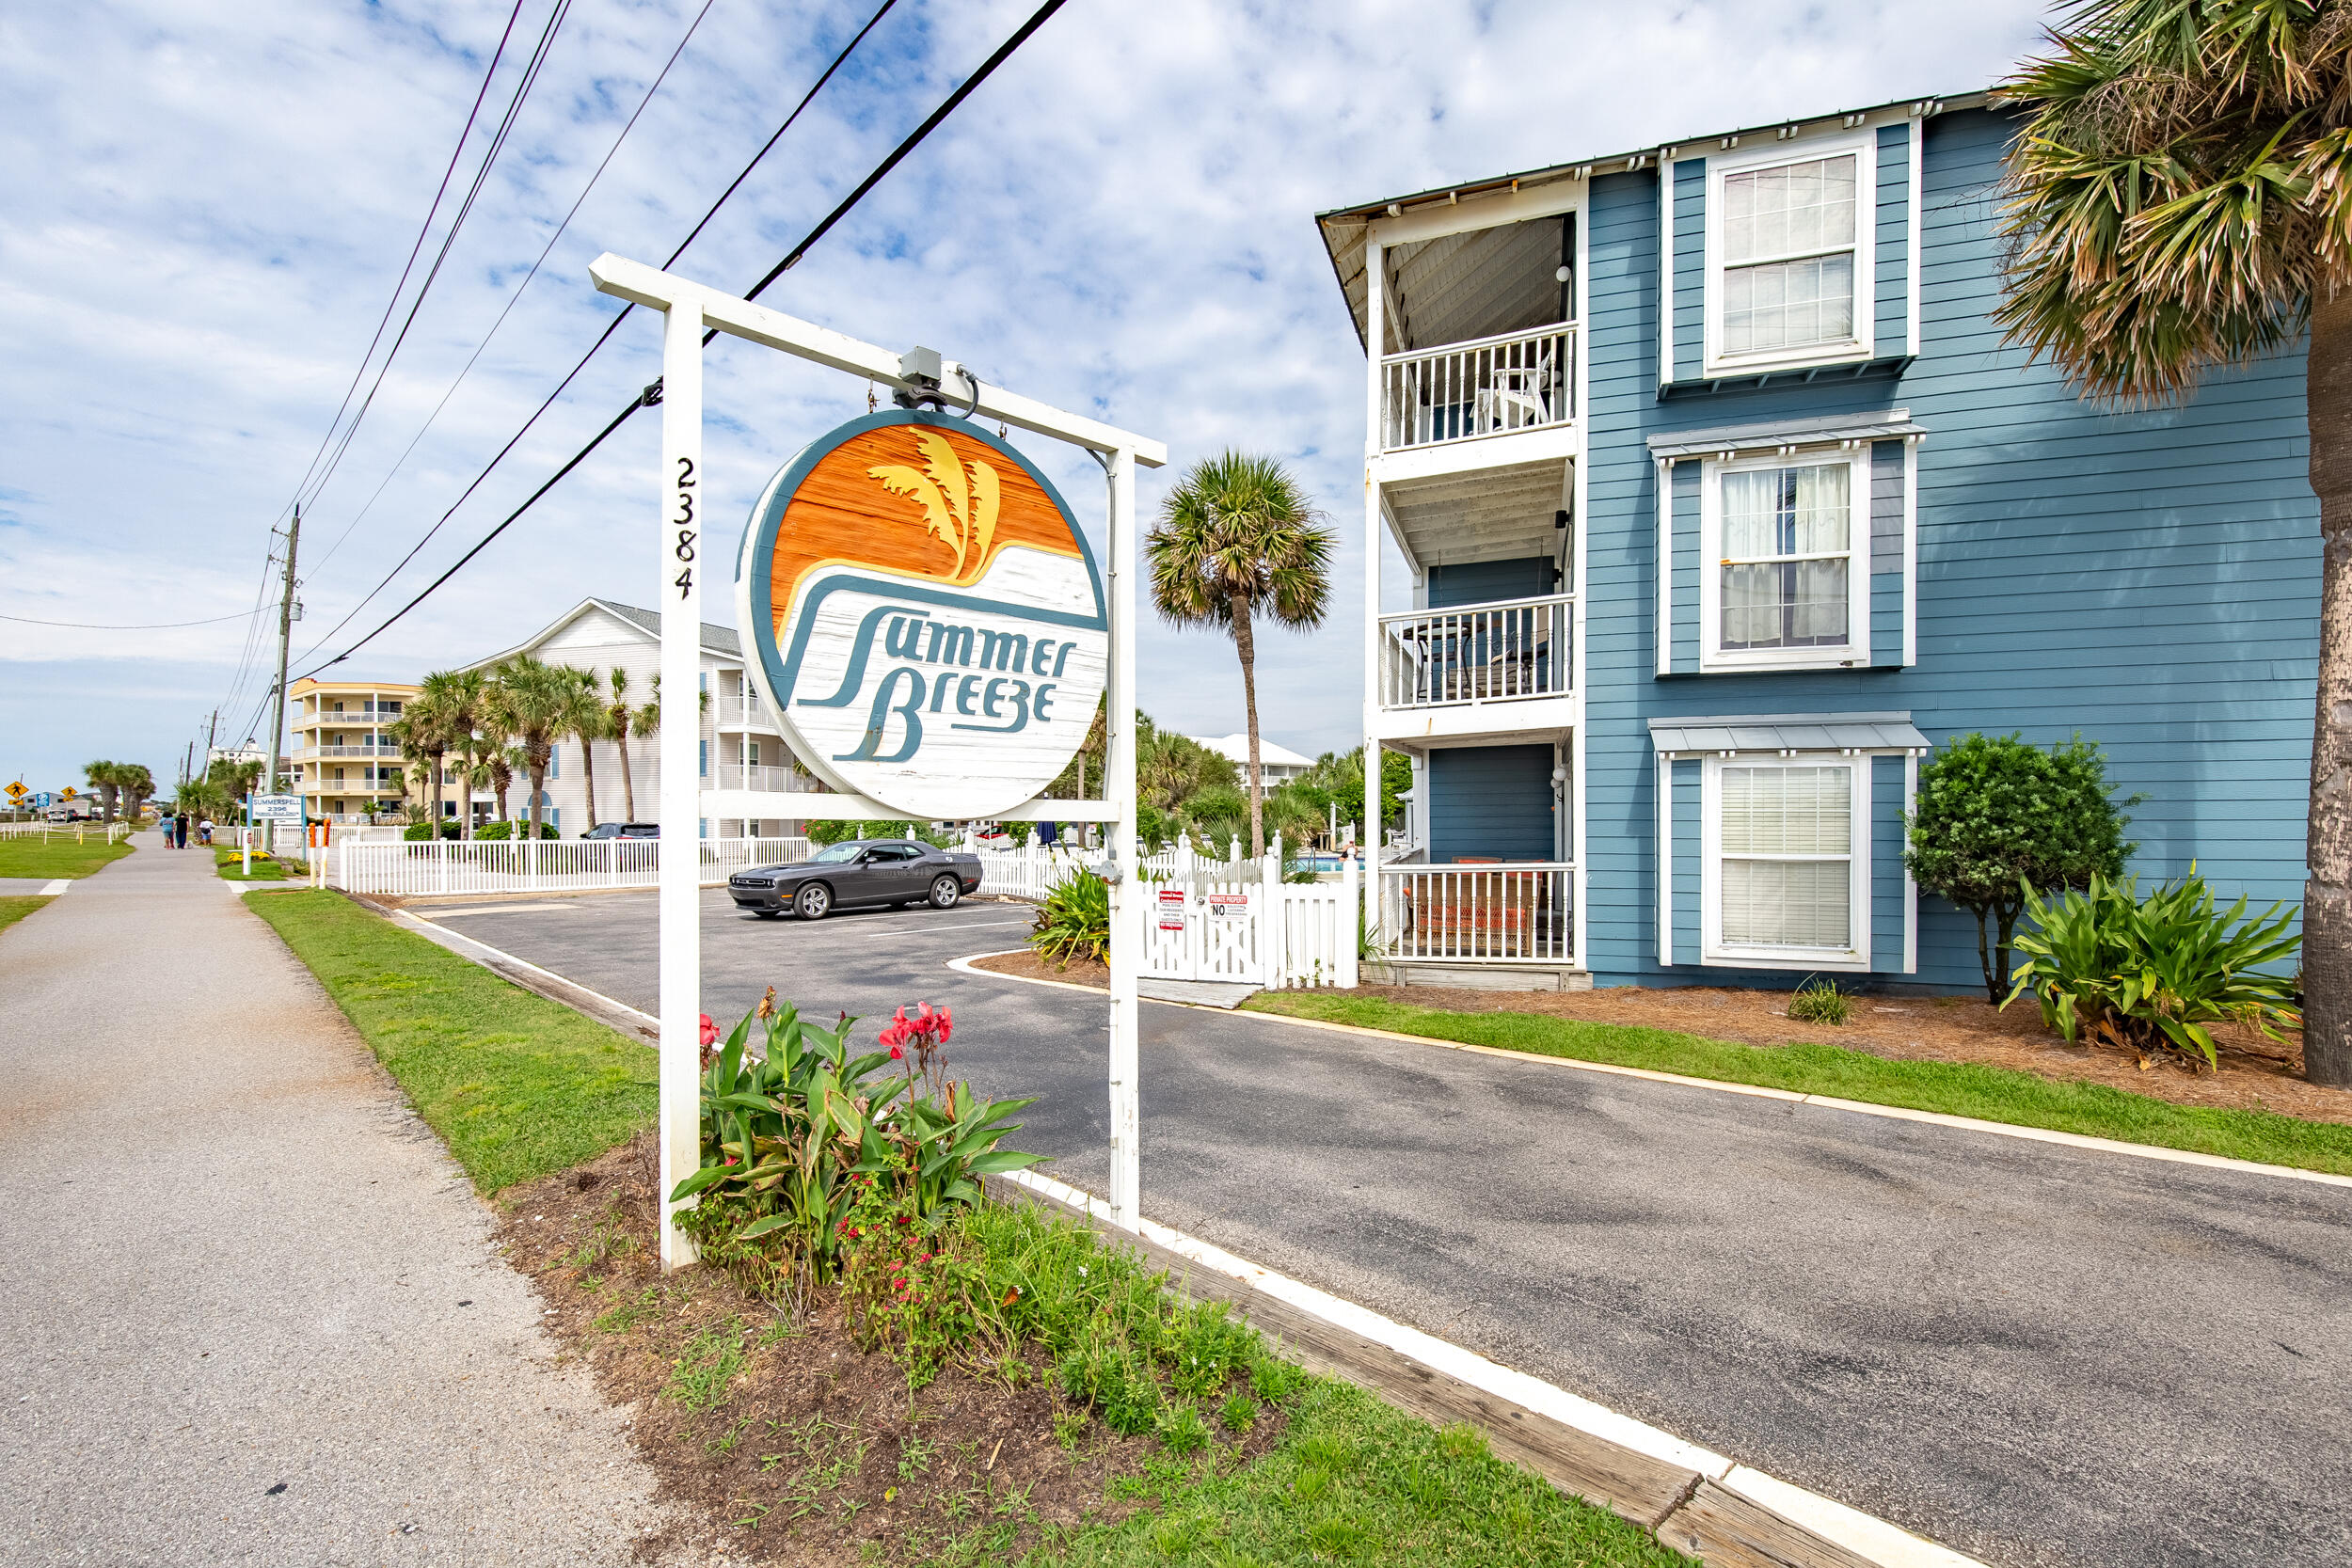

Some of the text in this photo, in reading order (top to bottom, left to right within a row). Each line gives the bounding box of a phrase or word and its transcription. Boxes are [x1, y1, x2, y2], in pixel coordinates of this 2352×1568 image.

[674, 457, 697, 601] 2384
[1211, 895, 1247, 904] PRIVATE PROPERTY
[1213, 904, 1225, 916] NO
